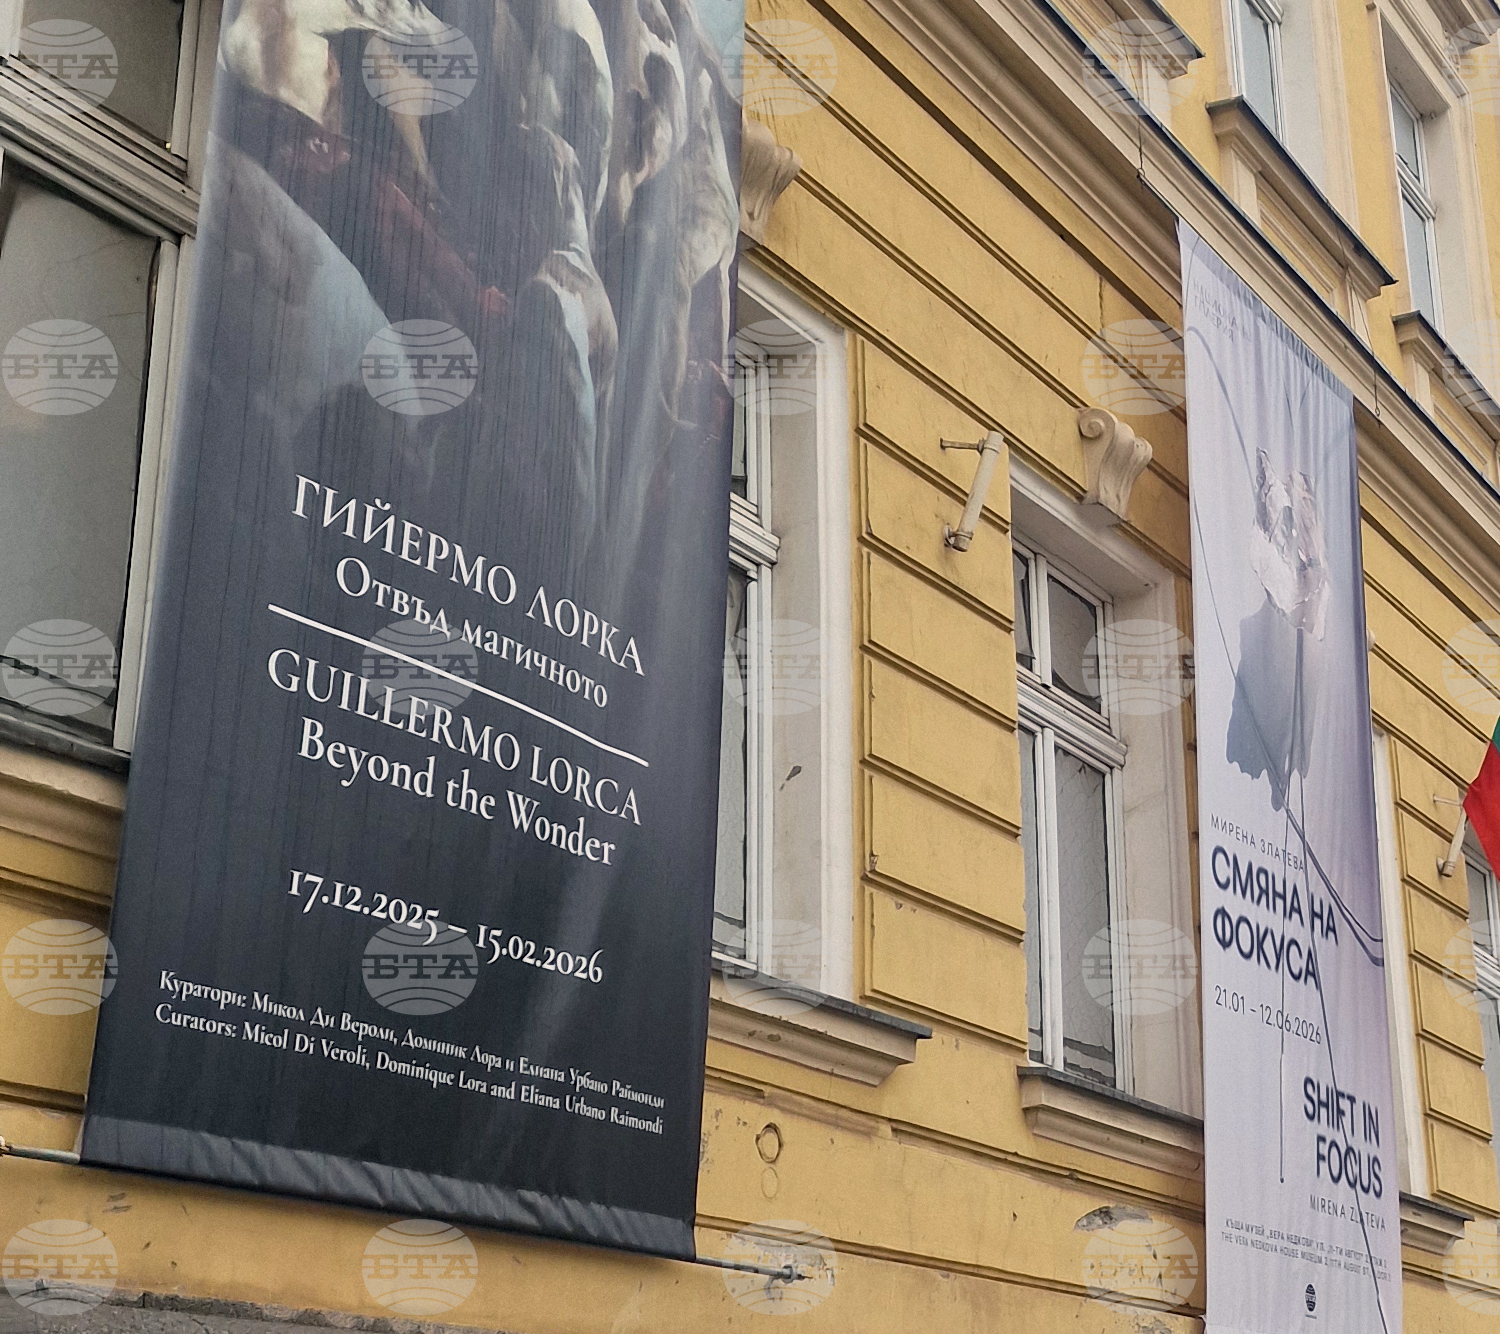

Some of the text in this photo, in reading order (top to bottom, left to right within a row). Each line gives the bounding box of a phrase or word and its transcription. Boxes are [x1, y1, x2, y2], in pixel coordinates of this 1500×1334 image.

[291, 474, 646, 677] ГИЙЕРМО ЛОРКА
[336, 557, 608, 708] Отвъд магичното
[267, 648, 642, 826] GUILLERMO LORCA
[297, 716, 616, 866] Beyond the Wonder
[1211, 813, 1305, 874] МИРЕНА ЗЛАТЕВА
[1211, 845, 1339, 947] СМЯНА НА
[287, 868, 440, 946] 17.12.2025
[476, 923, 604, 984] 15.02.2026
[1212, 905, 1319, 991] ФОКУСА
[154, 1002, 665, 1136] Curators: Micol Di Veroli, Dominique Lora and Eliana Urbano Raimondi
[159, 969, 248, 1011] Куратори:
[251, 990, 306, 1022] Микол
[309, 1006, 336, 1029] Ди
[339, 1011, 399, 1046] Вероли,
[470, 1044, 503, 1073] Лора
[569, 1067, 609, 1094] Урбано
[1214, 984, 1246, 1016] 21.01
[1259, 1002, 1322, 1045] 12.06.2026
[1303, 1075, 1381, 1149] SHIFT IN
[1315, 1133, 1384, 1200] FOCUS
[1309, 1193, 1347, 1219] MIRENA
